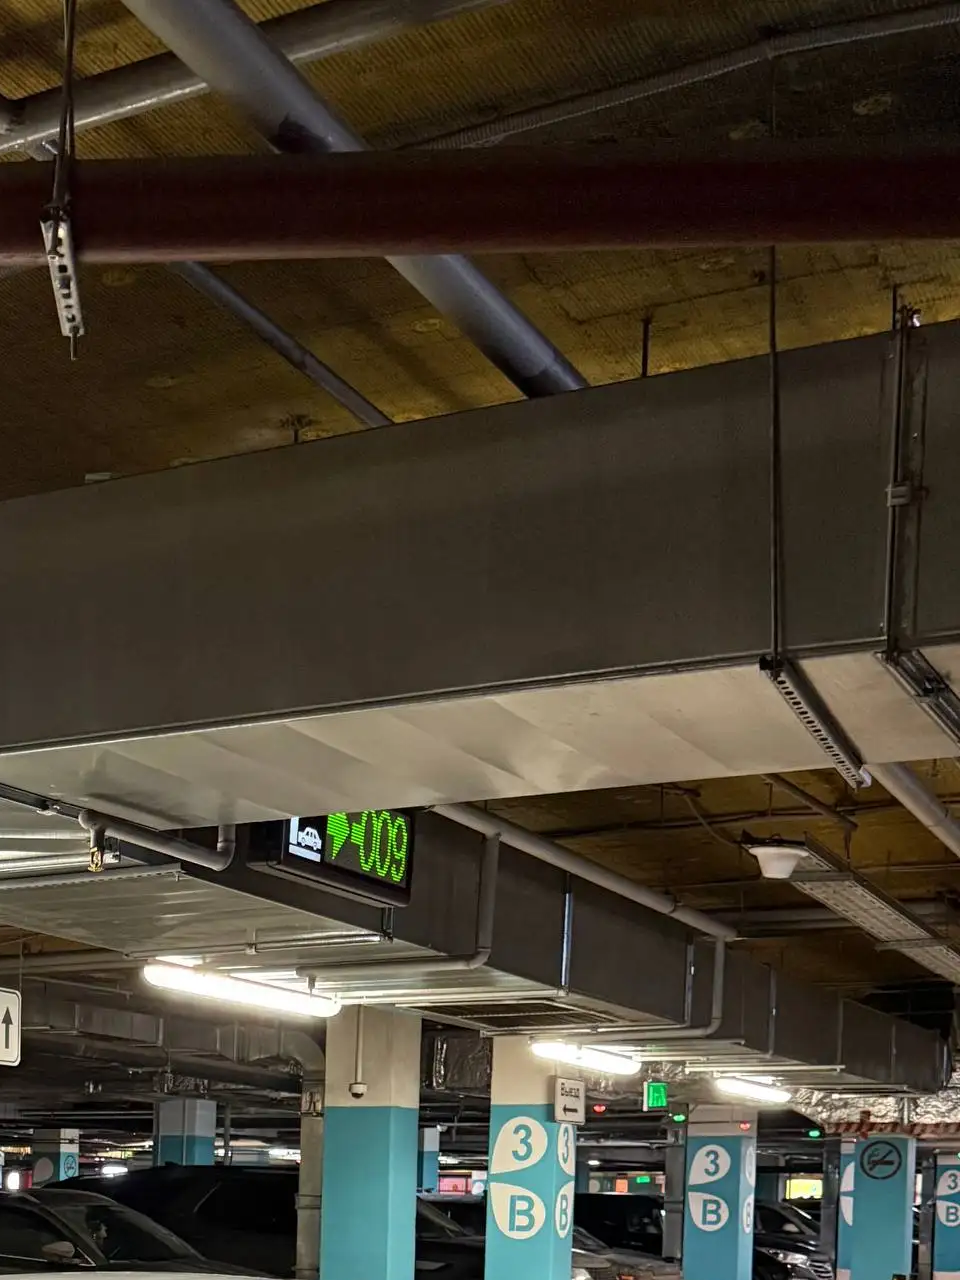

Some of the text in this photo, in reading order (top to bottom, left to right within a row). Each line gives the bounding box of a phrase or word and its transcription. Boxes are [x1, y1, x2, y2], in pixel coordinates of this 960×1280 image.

[358, 809, 408, 884] 009
[512, 1124, 533, 1162] 3
[703, 1149, 720, 1177] 3
[947, 1172, 959, 1190] 3
